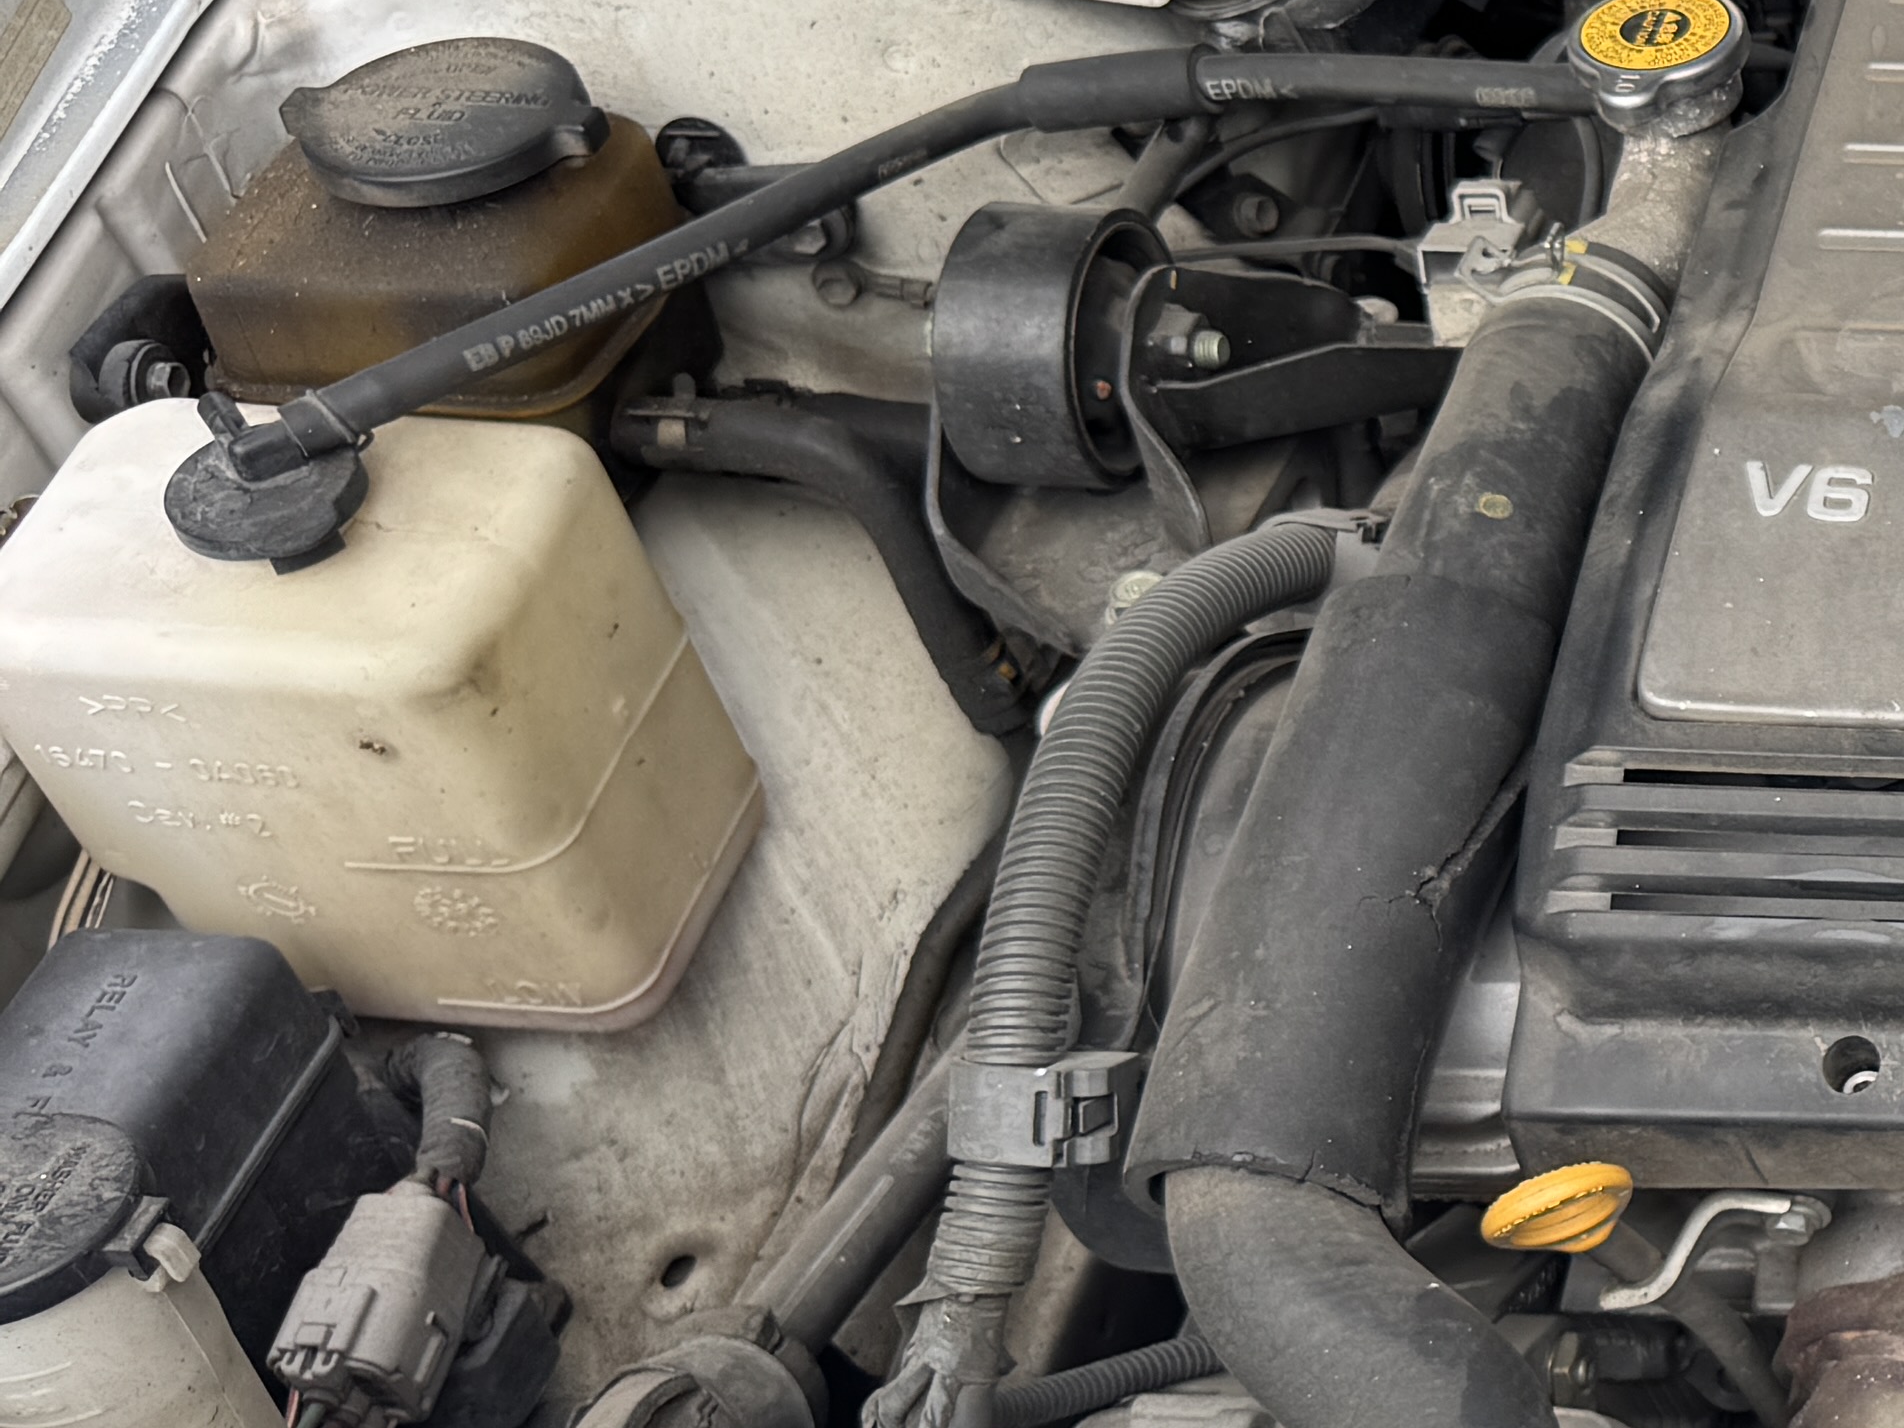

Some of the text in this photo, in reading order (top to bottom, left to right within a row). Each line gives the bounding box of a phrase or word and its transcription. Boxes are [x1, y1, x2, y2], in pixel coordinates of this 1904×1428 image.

[436, 89, 550, 108] STEERING
[1205, 77, 1274, 102] EPDM
[655, 242, 729, 292] EPDM
[1744, 460, 1876, 524] V6
[67, 973, 138, 1049] RELAY
